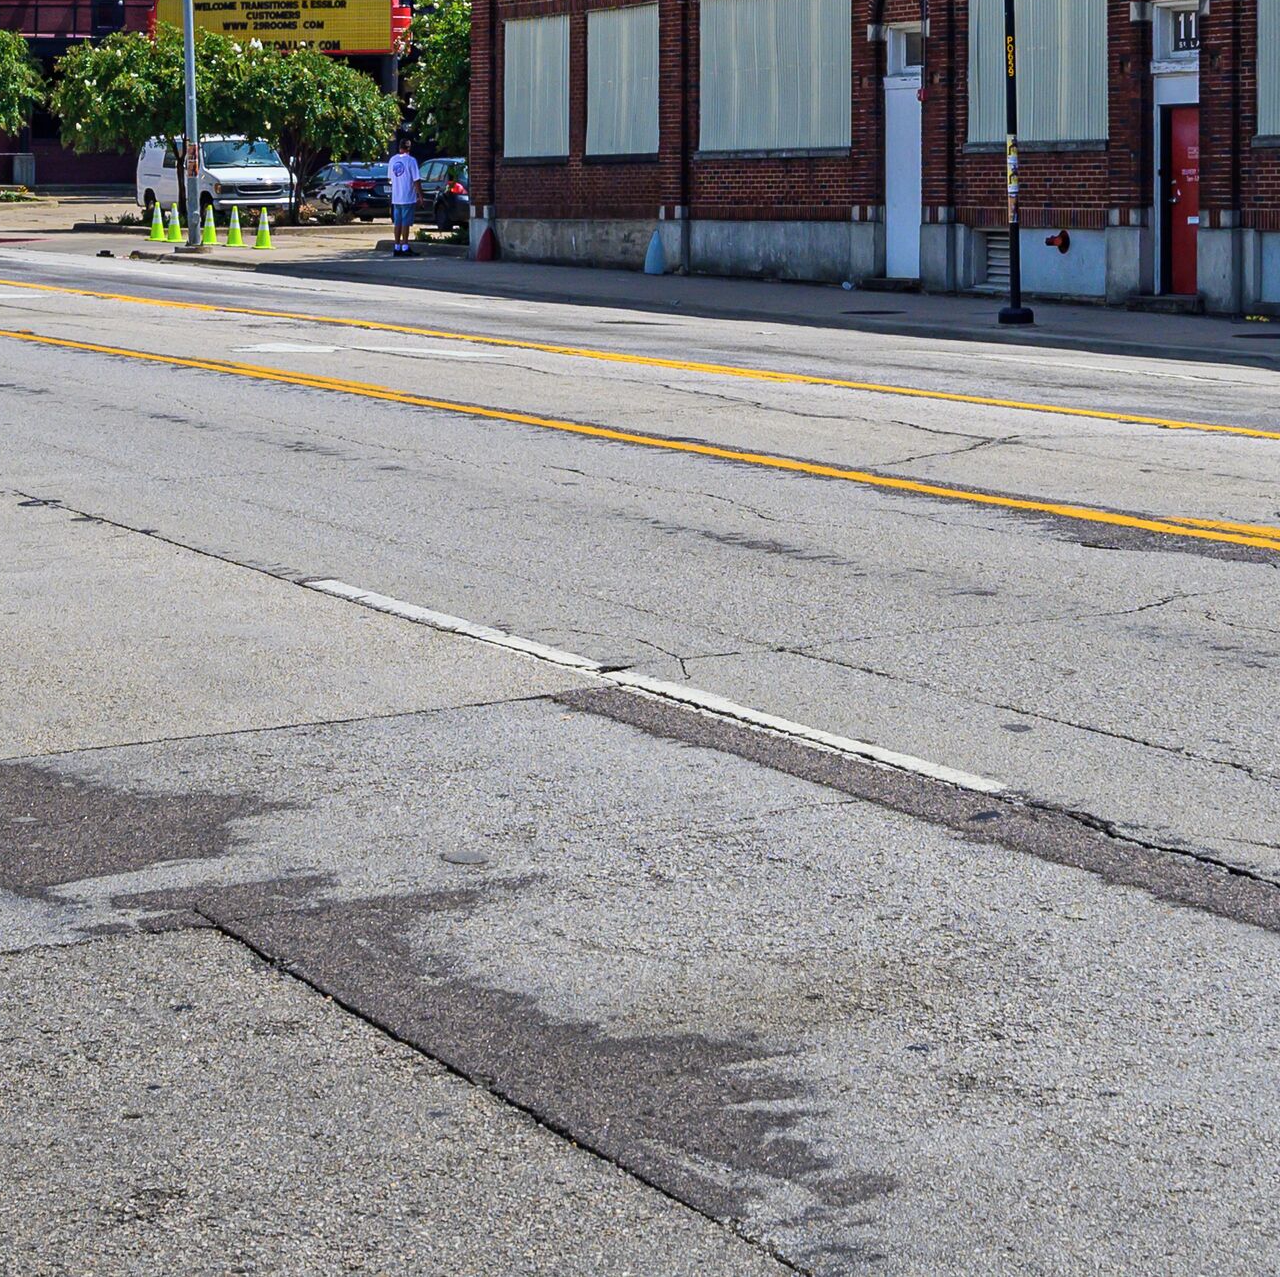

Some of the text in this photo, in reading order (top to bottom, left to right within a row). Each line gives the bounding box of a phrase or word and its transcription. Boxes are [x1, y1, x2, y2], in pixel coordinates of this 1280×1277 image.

[194, 0, 347, 11] WELCOME TRANSITIONS & ESSILOR
[245, 11, 301, 20] CUSTOMERS
[222, 20, 325, 30] WWW 29ROOMS COM
[318, 40, 341, 50] COM
